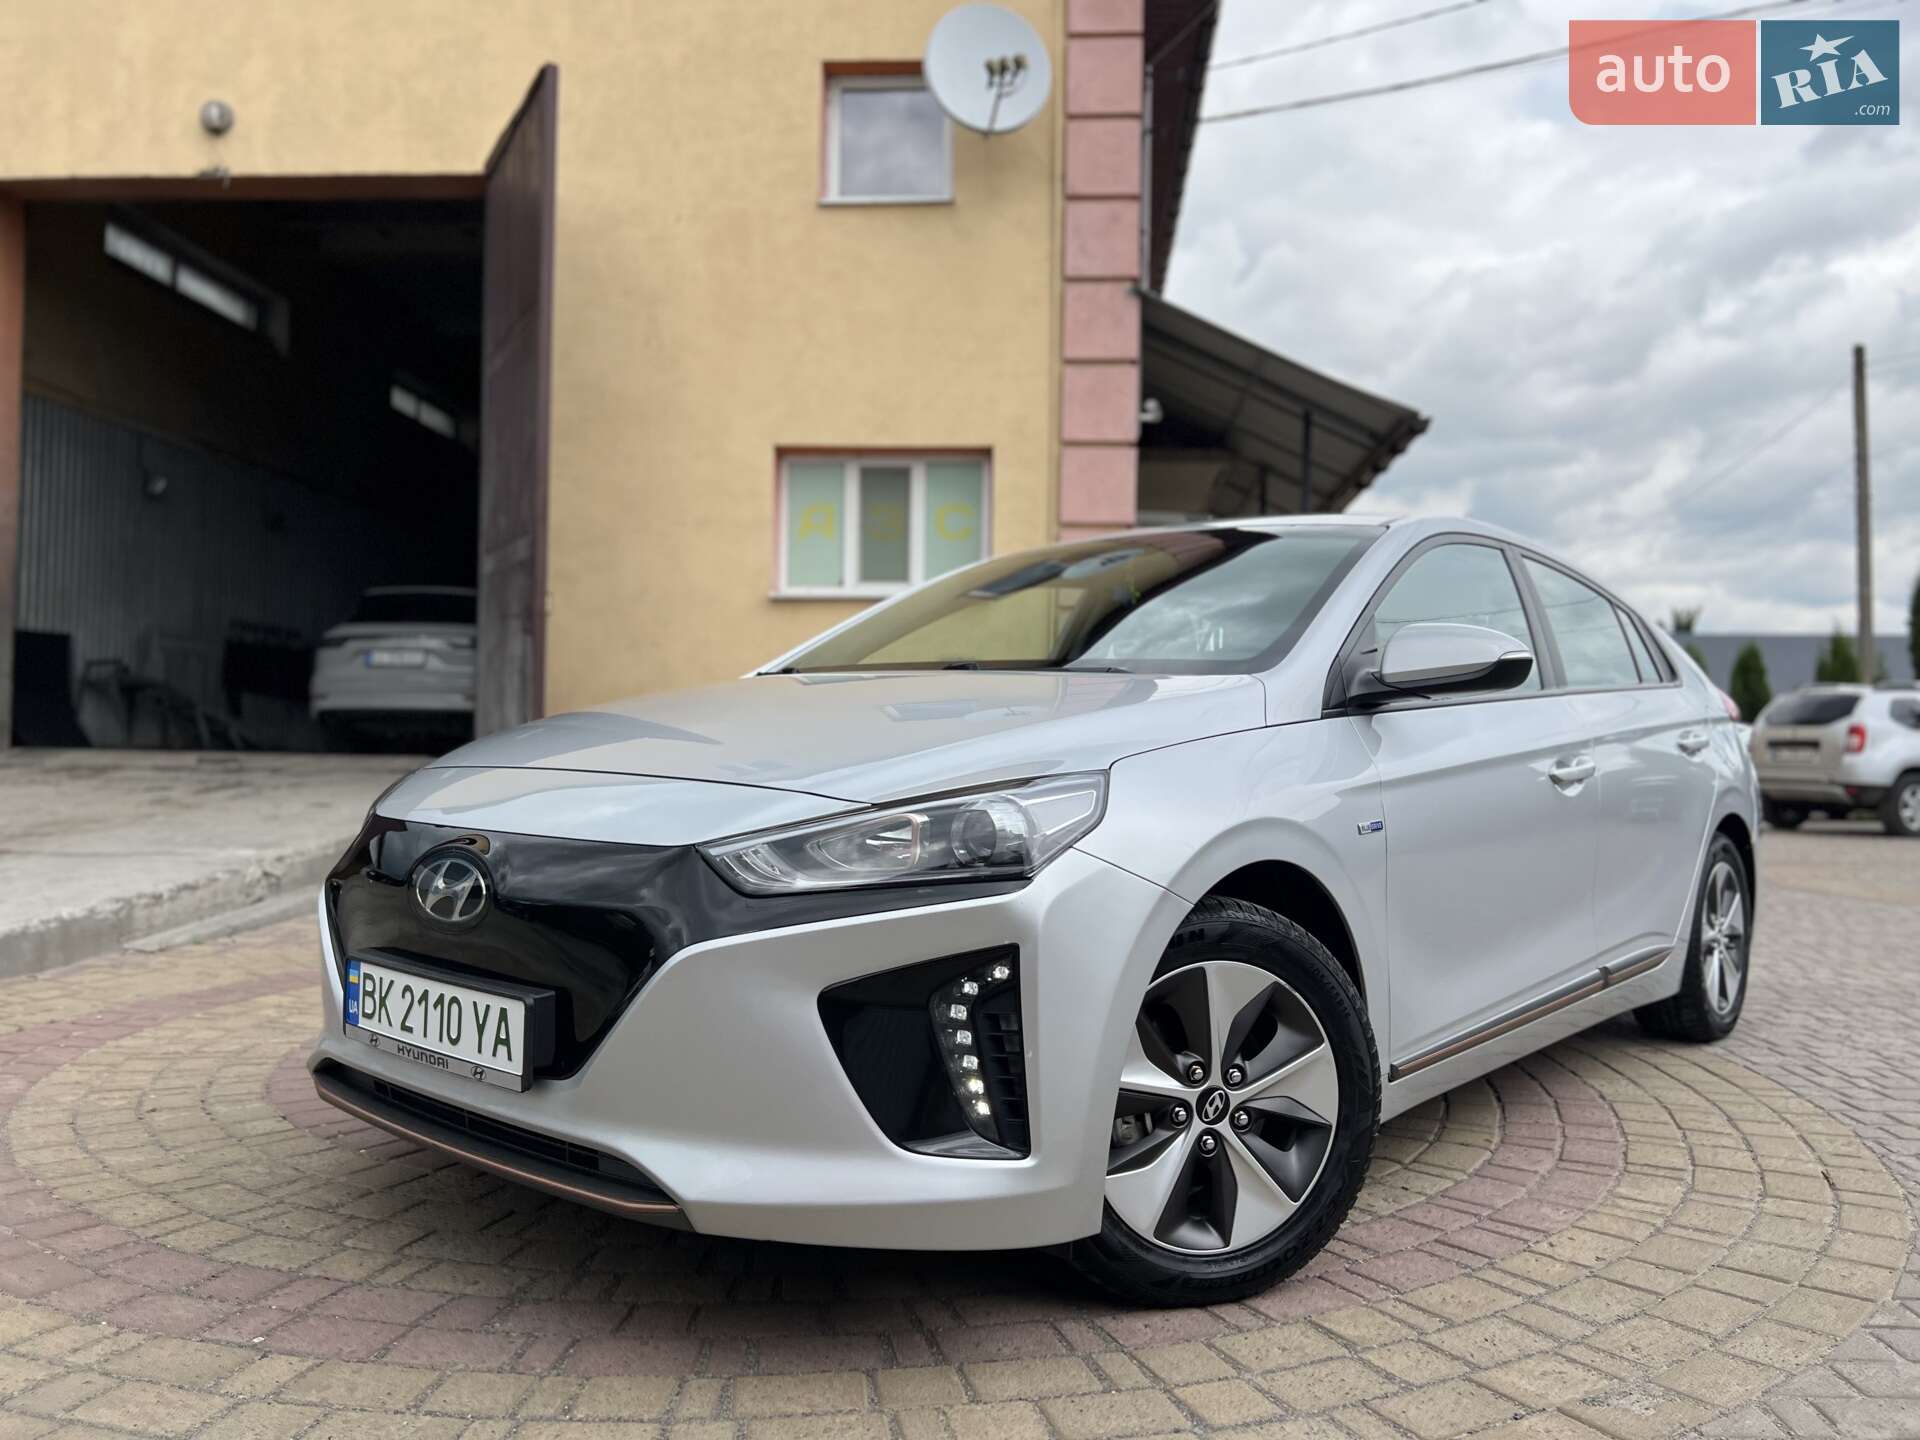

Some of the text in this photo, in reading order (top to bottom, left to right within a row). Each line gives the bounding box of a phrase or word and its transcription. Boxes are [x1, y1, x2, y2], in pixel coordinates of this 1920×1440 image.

[349, 1000, 358, 1013] UA
[362, 972, 512, 1061] BK 2110 YA
[397, 1044, 449, 1069] HYUNDAI
